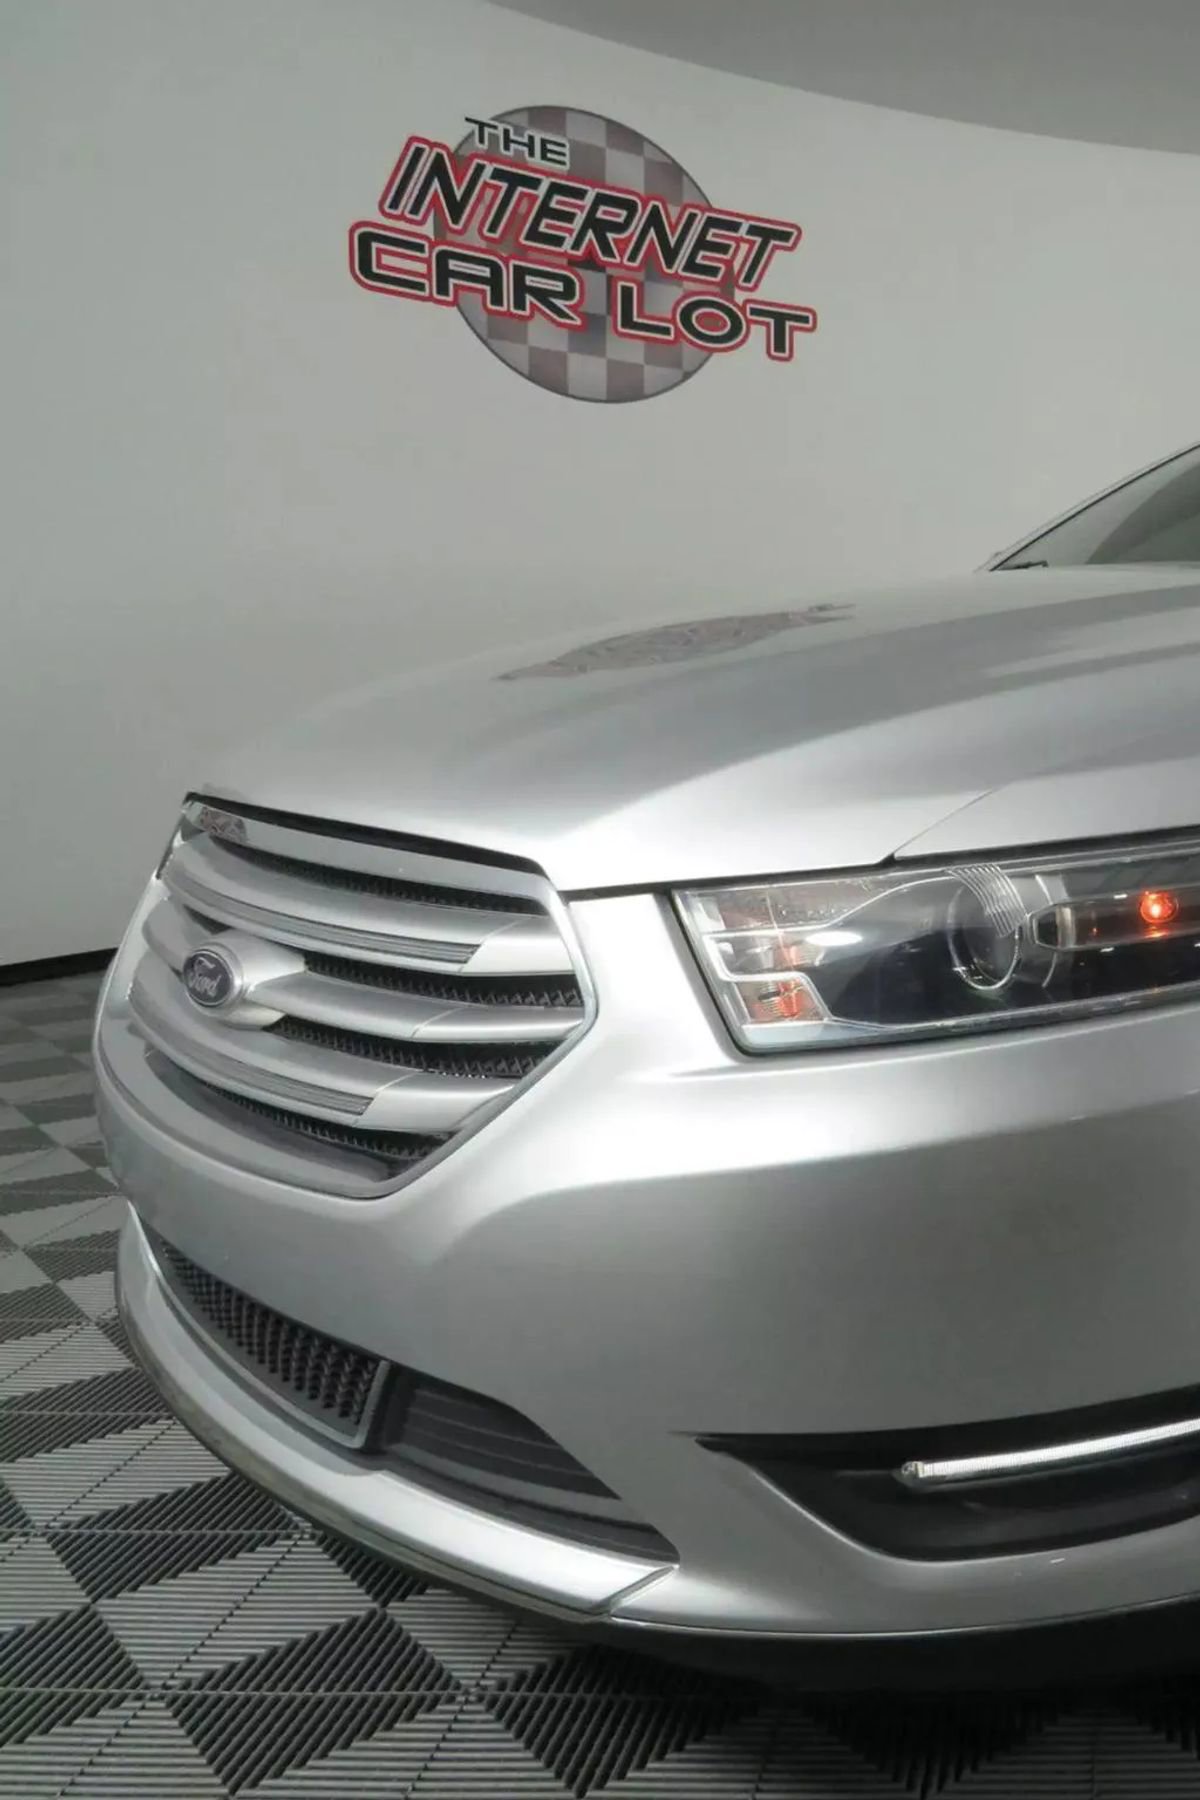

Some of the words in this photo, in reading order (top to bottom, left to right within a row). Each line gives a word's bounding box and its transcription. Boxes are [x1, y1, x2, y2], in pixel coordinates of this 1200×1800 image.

[464, 116, 569, 166] THE
[381, 139, 801, 287] INTERNET
[351, 224, 583, 329] CAR
[614, 277, 815, 359] LOT
[187, 956, 222, 998] Ford
